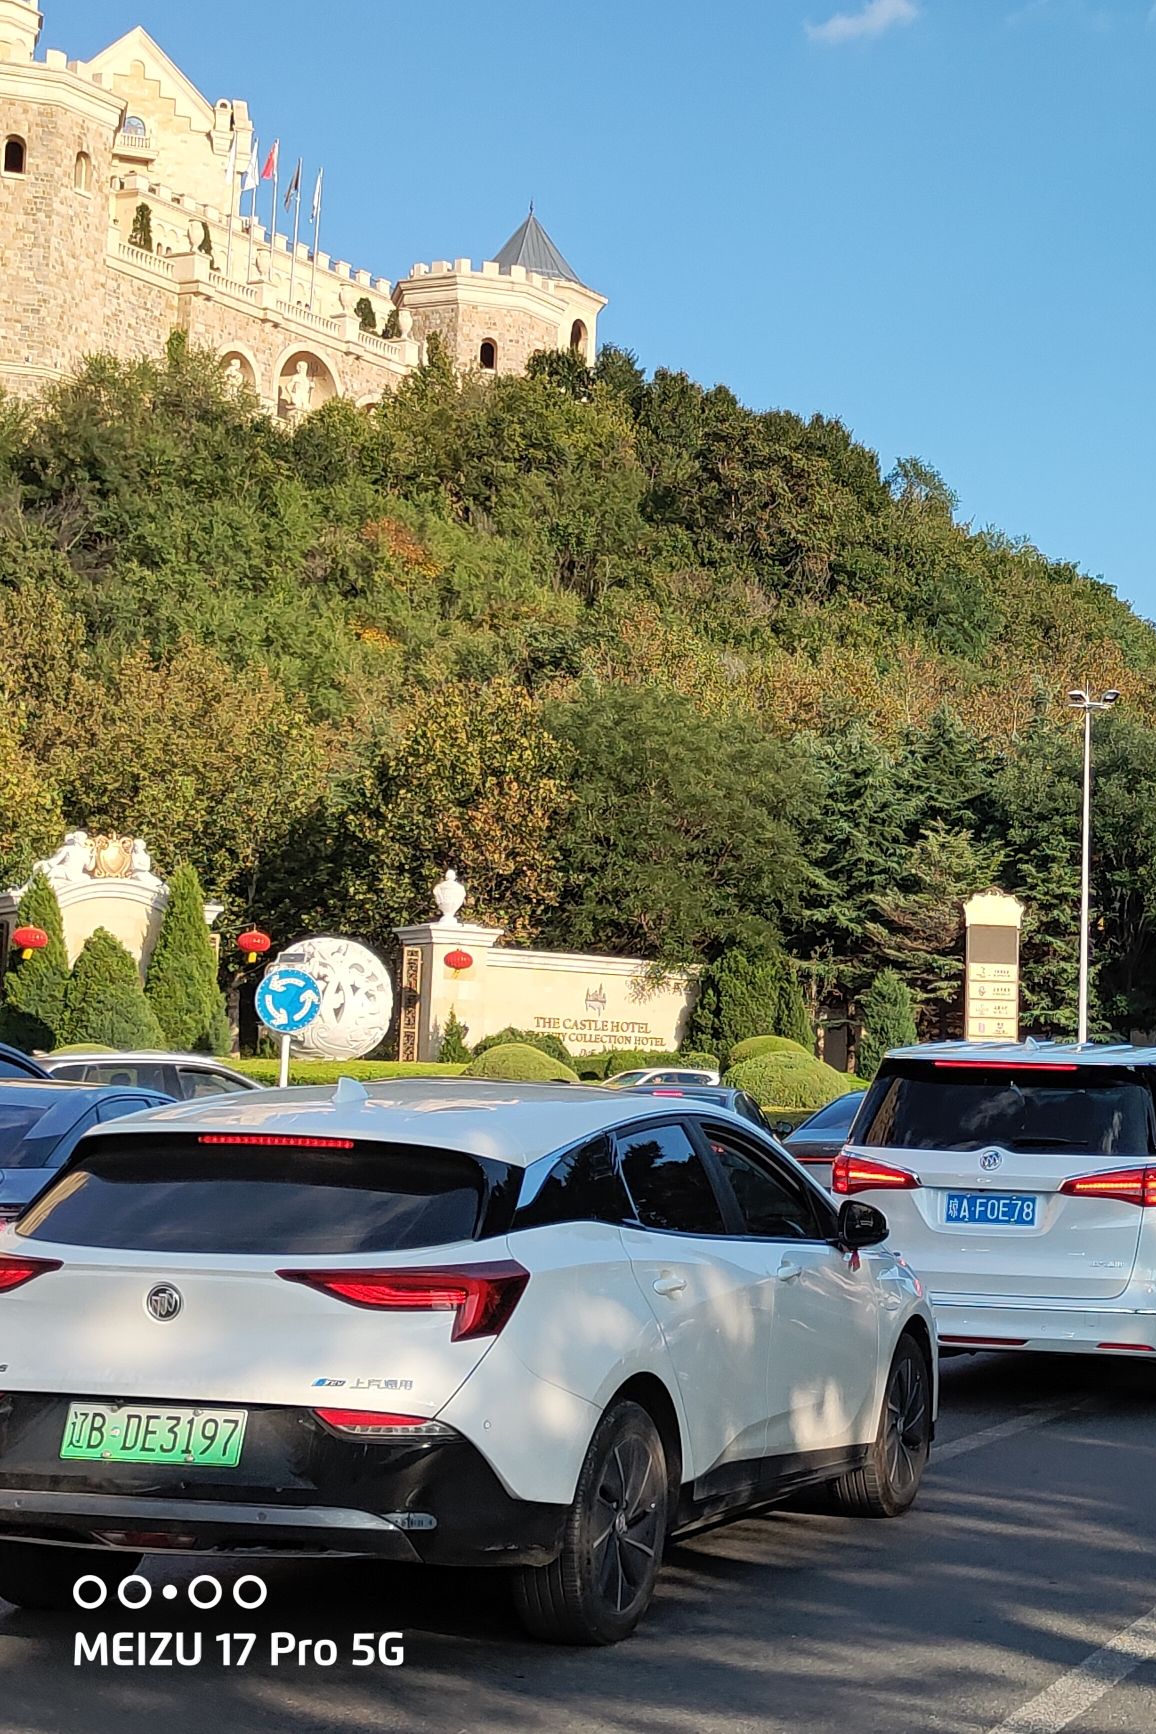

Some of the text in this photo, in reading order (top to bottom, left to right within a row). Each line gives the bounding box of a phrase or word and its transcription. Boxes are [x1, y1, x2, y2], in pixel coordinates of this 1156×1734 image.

[534, 1016, 651, 1034] THE CASTLE HOTEL
[568, 1032, 632, 1045] COLLECTION
[634, 1036, 667, 1047] HOTEL
